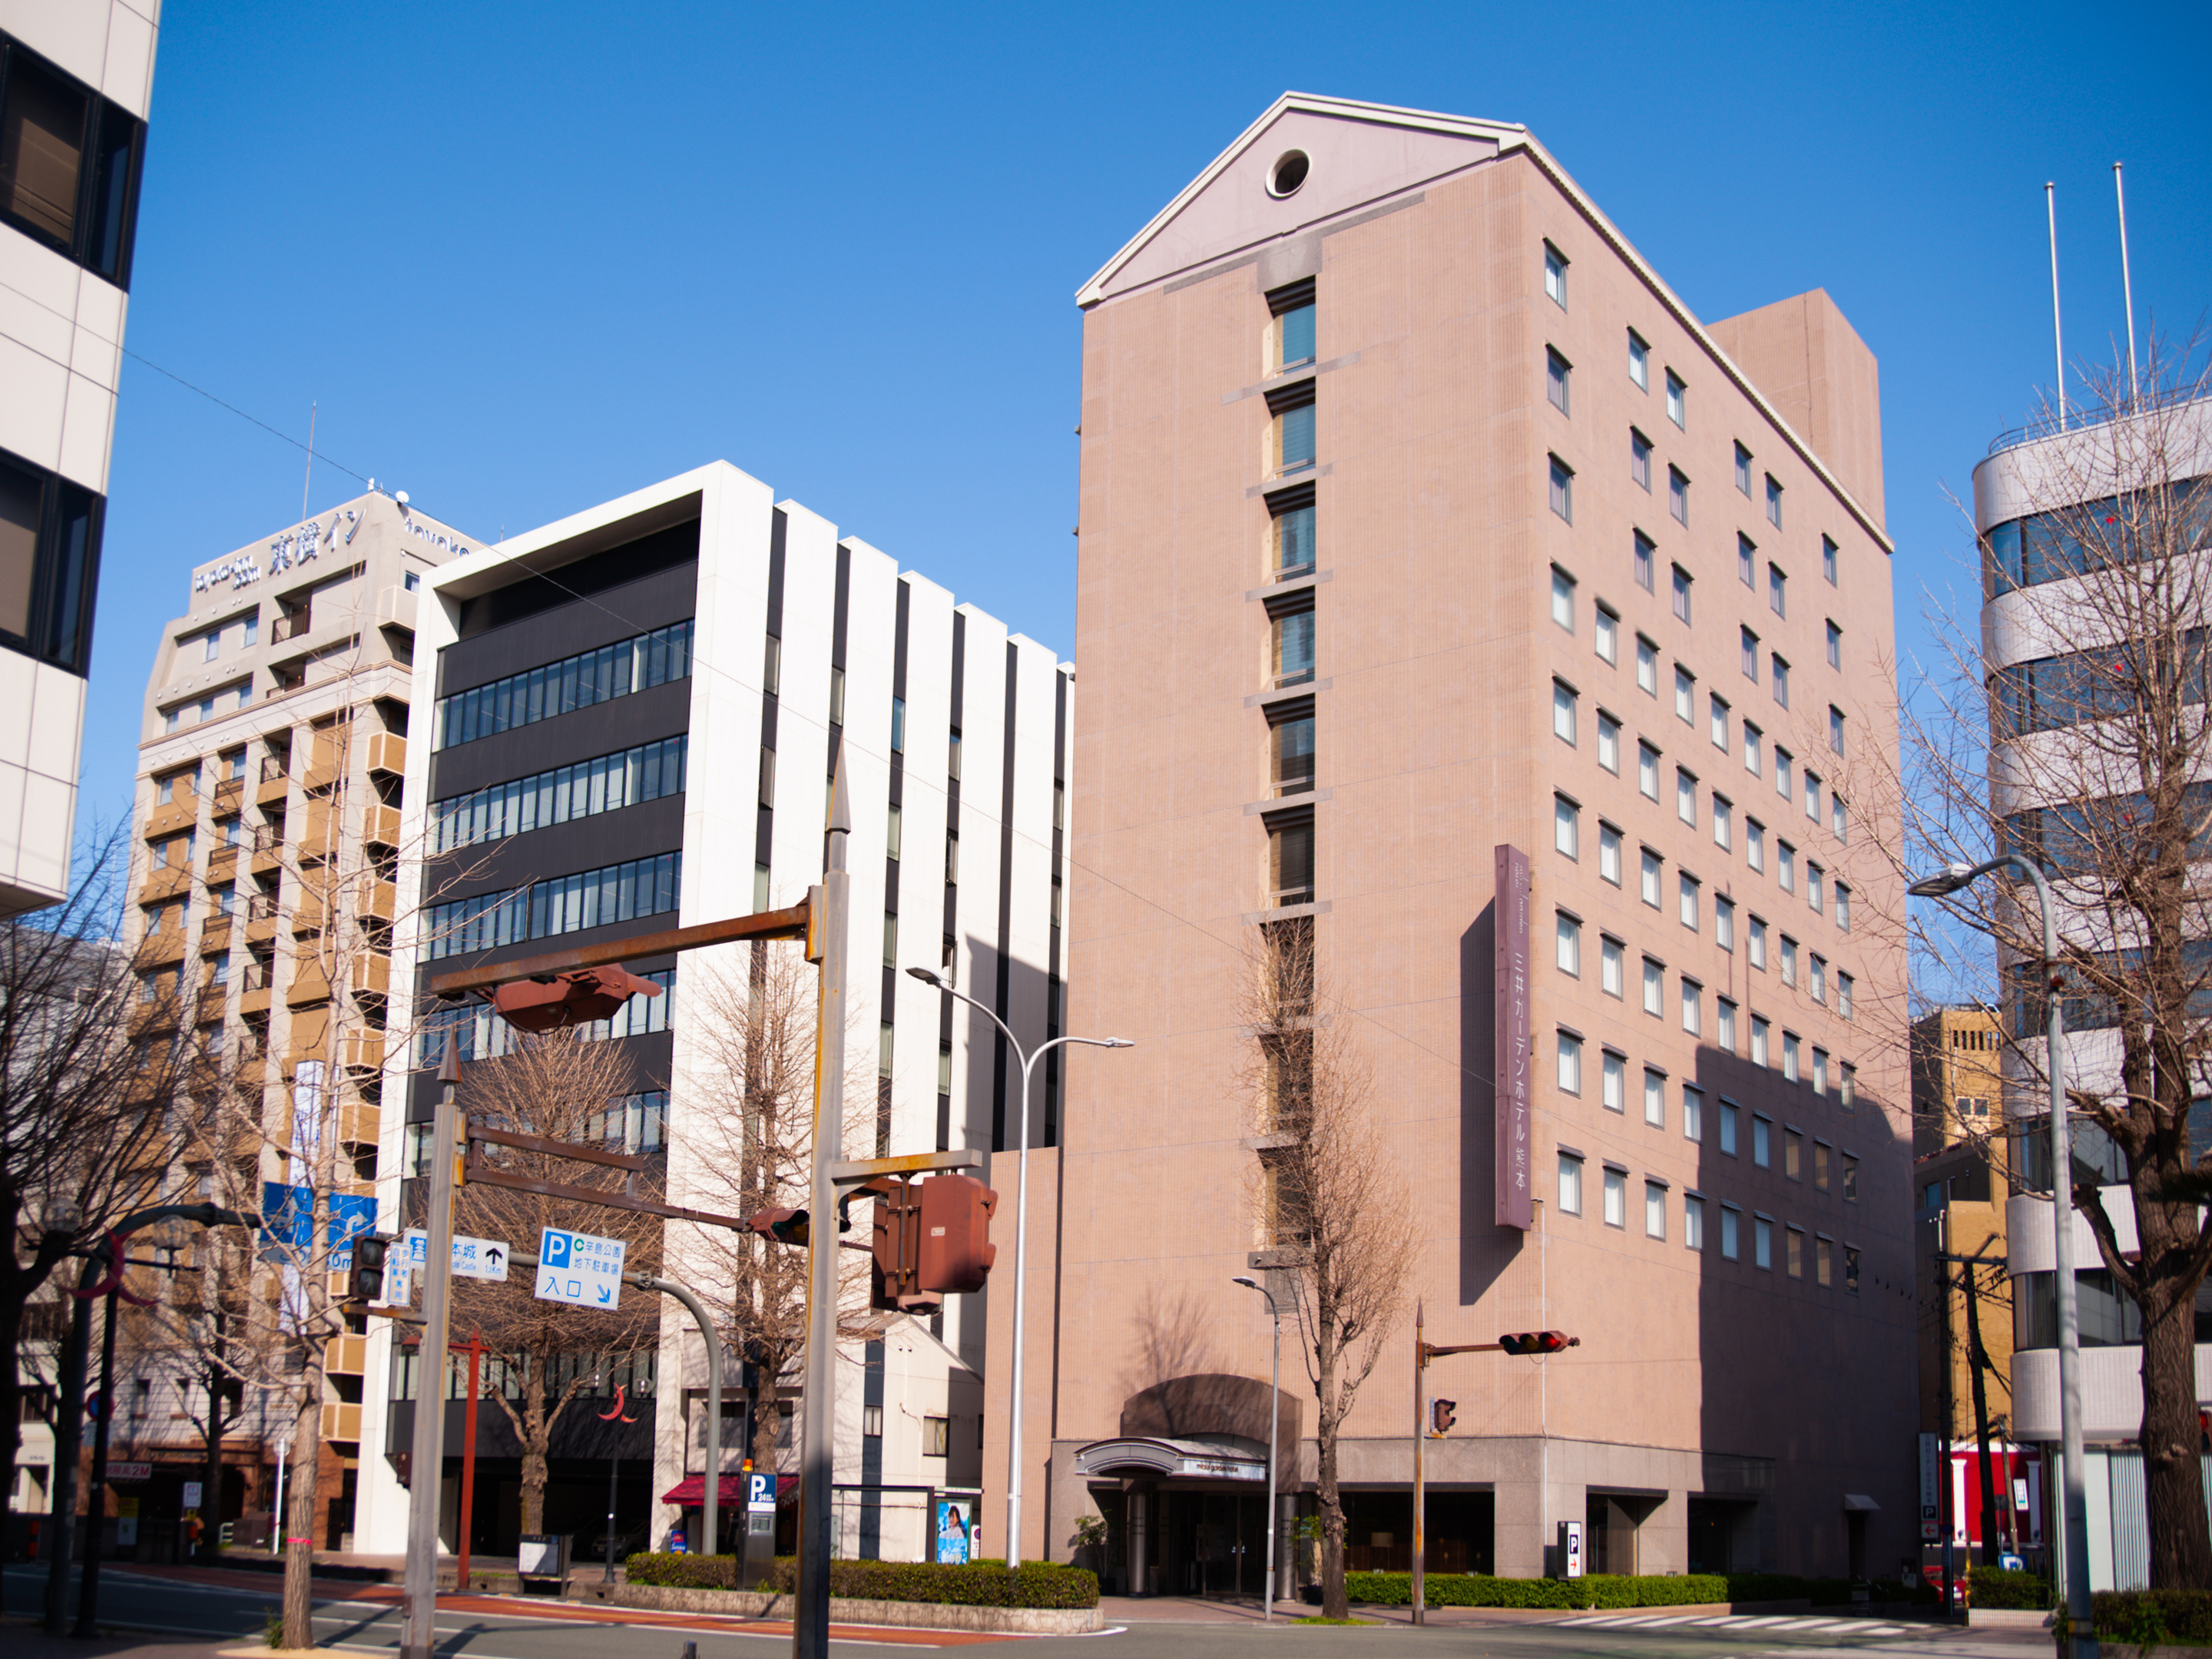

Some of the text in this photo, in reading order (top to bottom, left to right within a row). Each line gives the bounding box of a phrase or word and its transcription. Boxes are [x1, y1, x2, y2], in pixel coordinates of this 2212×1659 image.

[268, 508, 367, 577] 東横イン
[1515, 952, 1526, 1190] 三井ガーデンホテル熊本
[452, 1241, 476, 1260] 本城
[548, 1234, 566, 1263] P
[585, 1240, 621, 1258] 辛島公園
[545, 1277, 581, 1298] 入口
[750, 1475, 767, 1502] P
[1926, 1507, 1934, 1517] P
[1571, 1536, 1578, 1553] P
